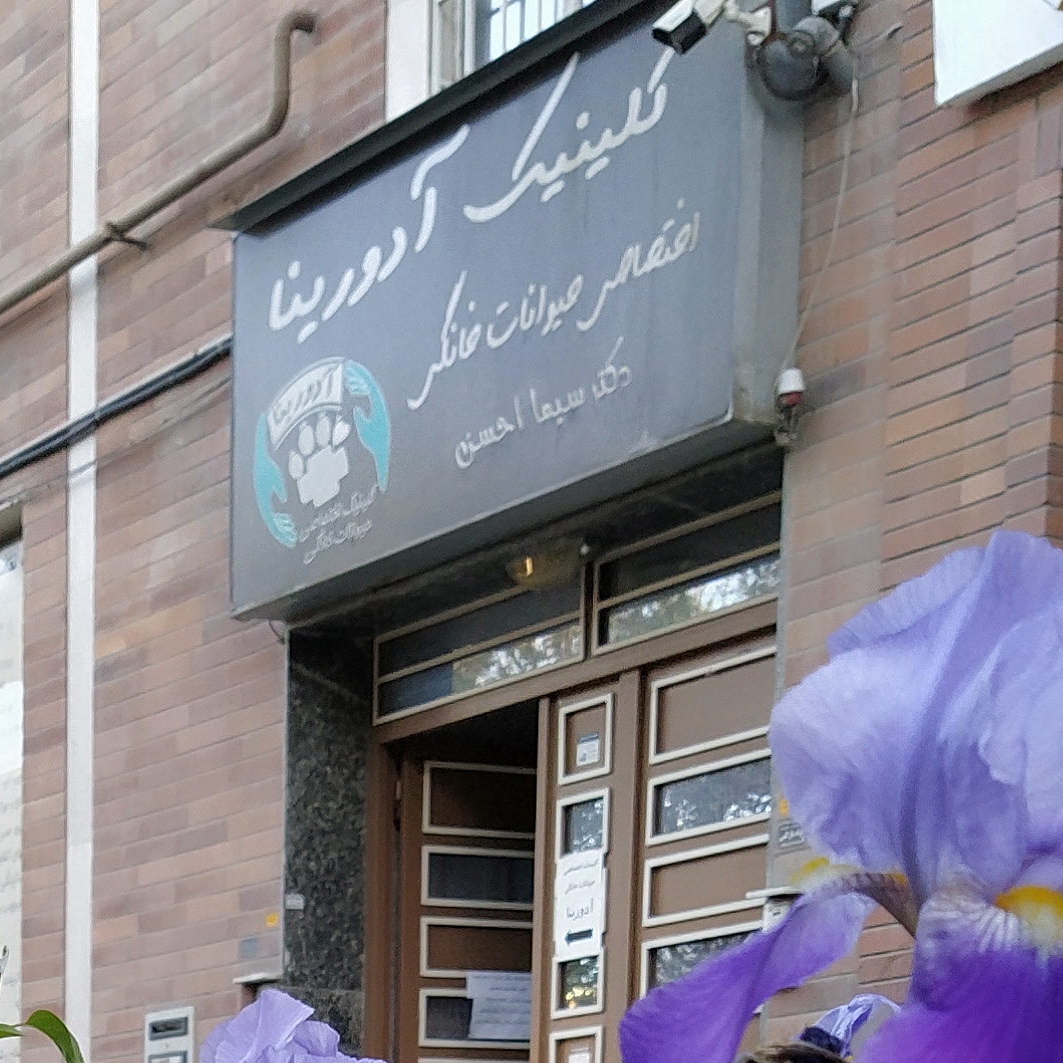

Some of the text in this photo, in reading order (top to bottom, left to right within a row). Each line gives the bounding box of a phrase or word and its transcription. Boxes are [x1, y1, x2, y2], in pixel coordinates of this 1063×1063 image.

[269, 48, 677, 343] کلینیک آدورینا
[407, 198, 700, 410] اختصاصی حیوانات خانگی
[592, 335, 633, 400] دکتر
[530, 388, 586, 426] سیما
